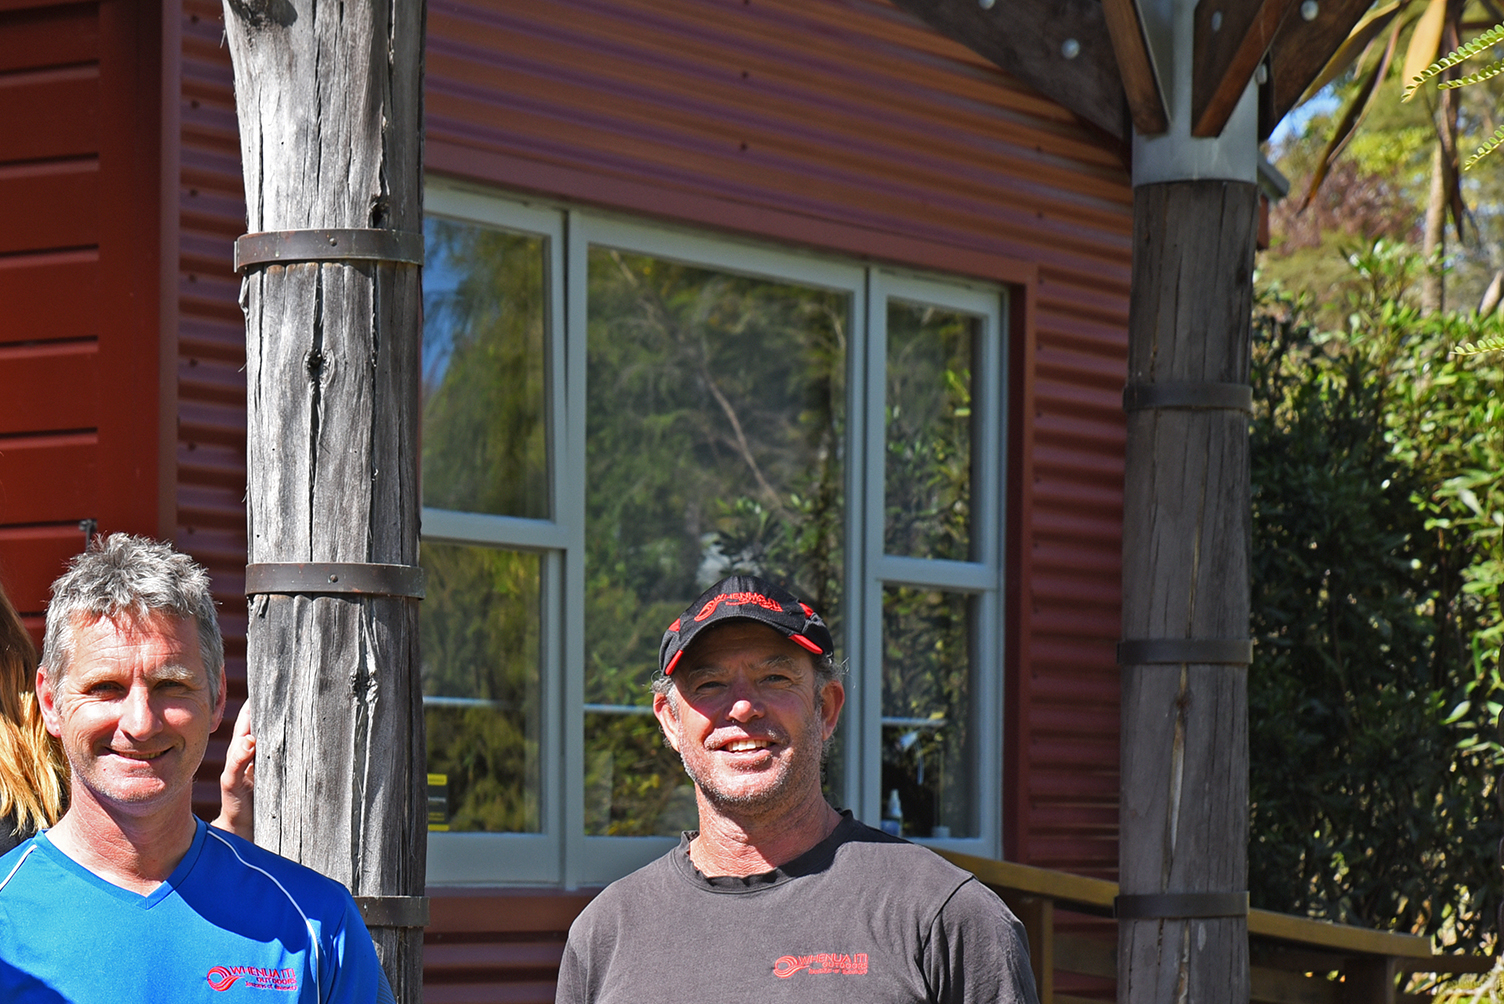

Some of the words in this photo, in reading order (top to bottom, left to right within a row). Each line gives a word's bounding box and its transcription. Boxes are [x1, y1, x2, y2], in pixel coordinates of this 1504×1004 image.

[798, 953, 851, 965] WHENUA
[854, 953, 868, 964] ITI
[821, 961, 868, 970] OUTDOORS
[229, 965, 280, 979] WHENUA
[281, 968, 296, 979] ITI
[256, 976, 298, 986] OUTDOORS
